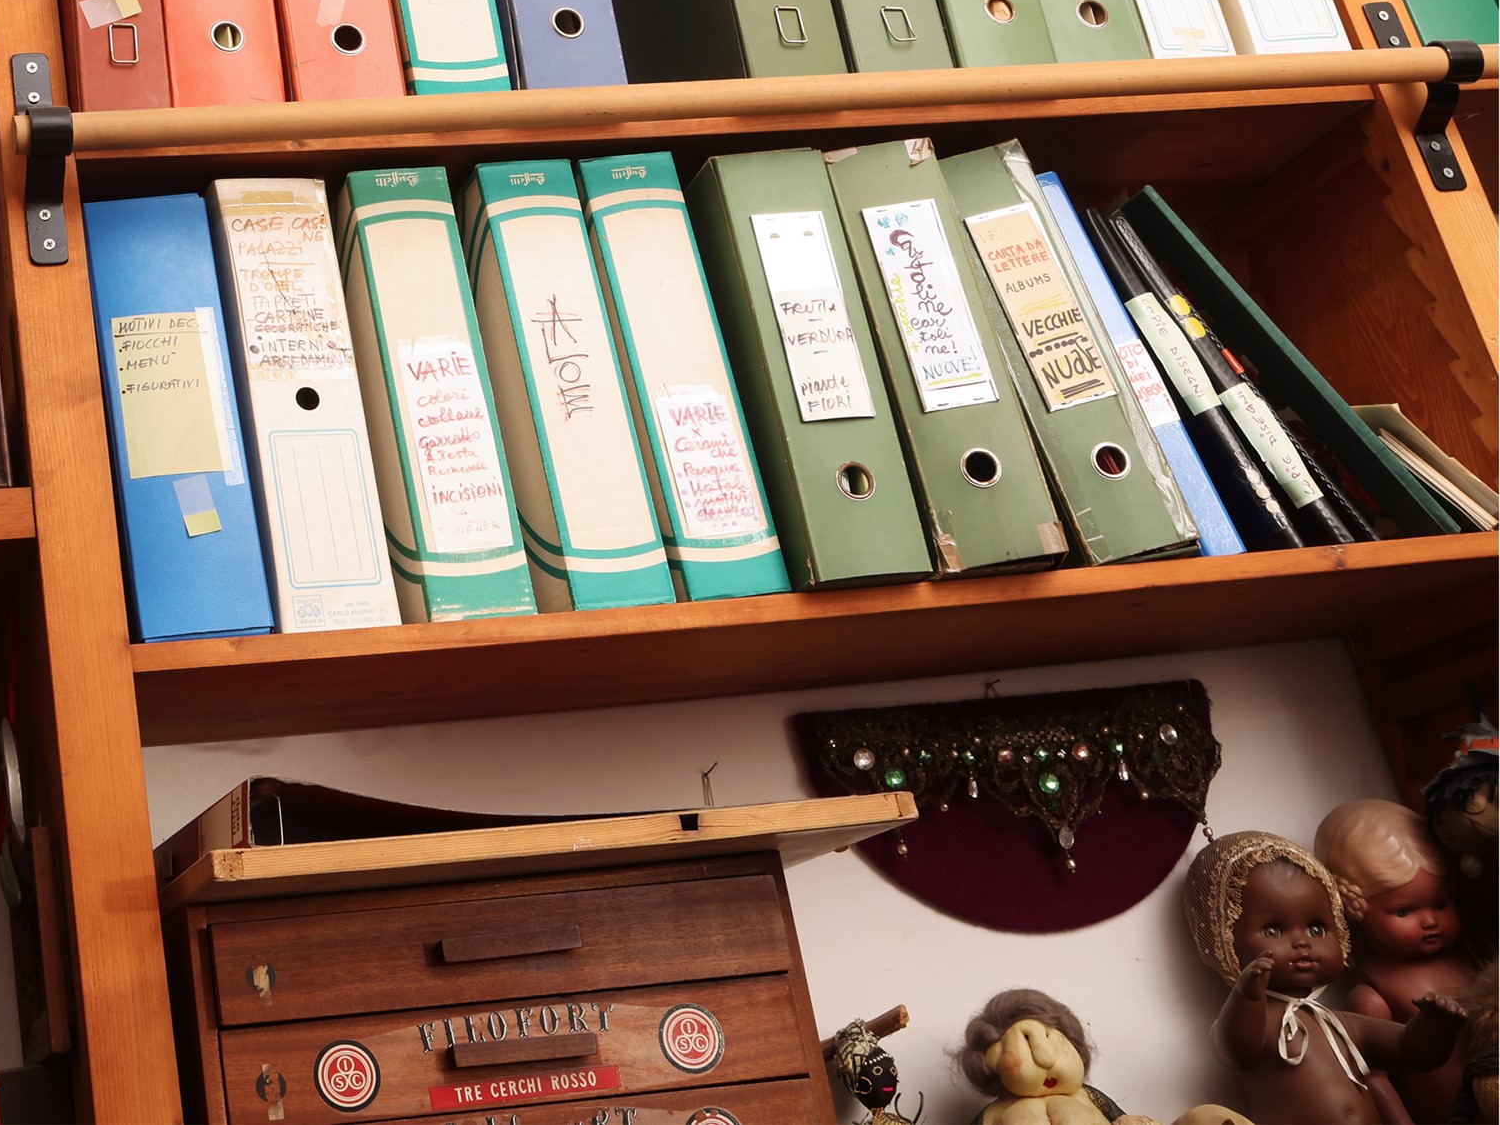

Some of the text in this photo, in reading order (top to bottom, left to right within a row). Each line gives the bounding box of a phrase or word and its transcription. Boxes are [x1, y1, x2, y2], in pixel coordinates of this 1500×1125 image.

[375, 172, 420, 188] Buffetti
[509, 172, 546, 186] Buffetti
[611, 165, 647, 180] Buffetti
[238, 241, 303, 257] PALAZZI
[988, 237, 1044, 262] CARTA DA
[994, 250, 1050, 274] LETTERE
[1005, 272, 1051, 294] ALBUMS
[780, 299, 837, 316] FRUTTA
[119, 317, 161, 333] MOTIVI
[1021, 307, 1084, 339] VECCHIE
[787, 327, 854, 347] VERDURA
[406, 351, 473, 383] VARIE
[1169, 345, 1206, 400] DISEGNI
[127, 378, 200, 393] FIGURATIVI
[417, 387, 471, 408] colori
[808, 391, 852, 412] FIORI
[668, 402, 730, 427] VARIE
[1236, 390, 1278, 447] DISEGNI
[417, 1002, 615, 1055] FILOFORT
[454, 1071, 597, 1103] TRE CERCHI ROSSO
